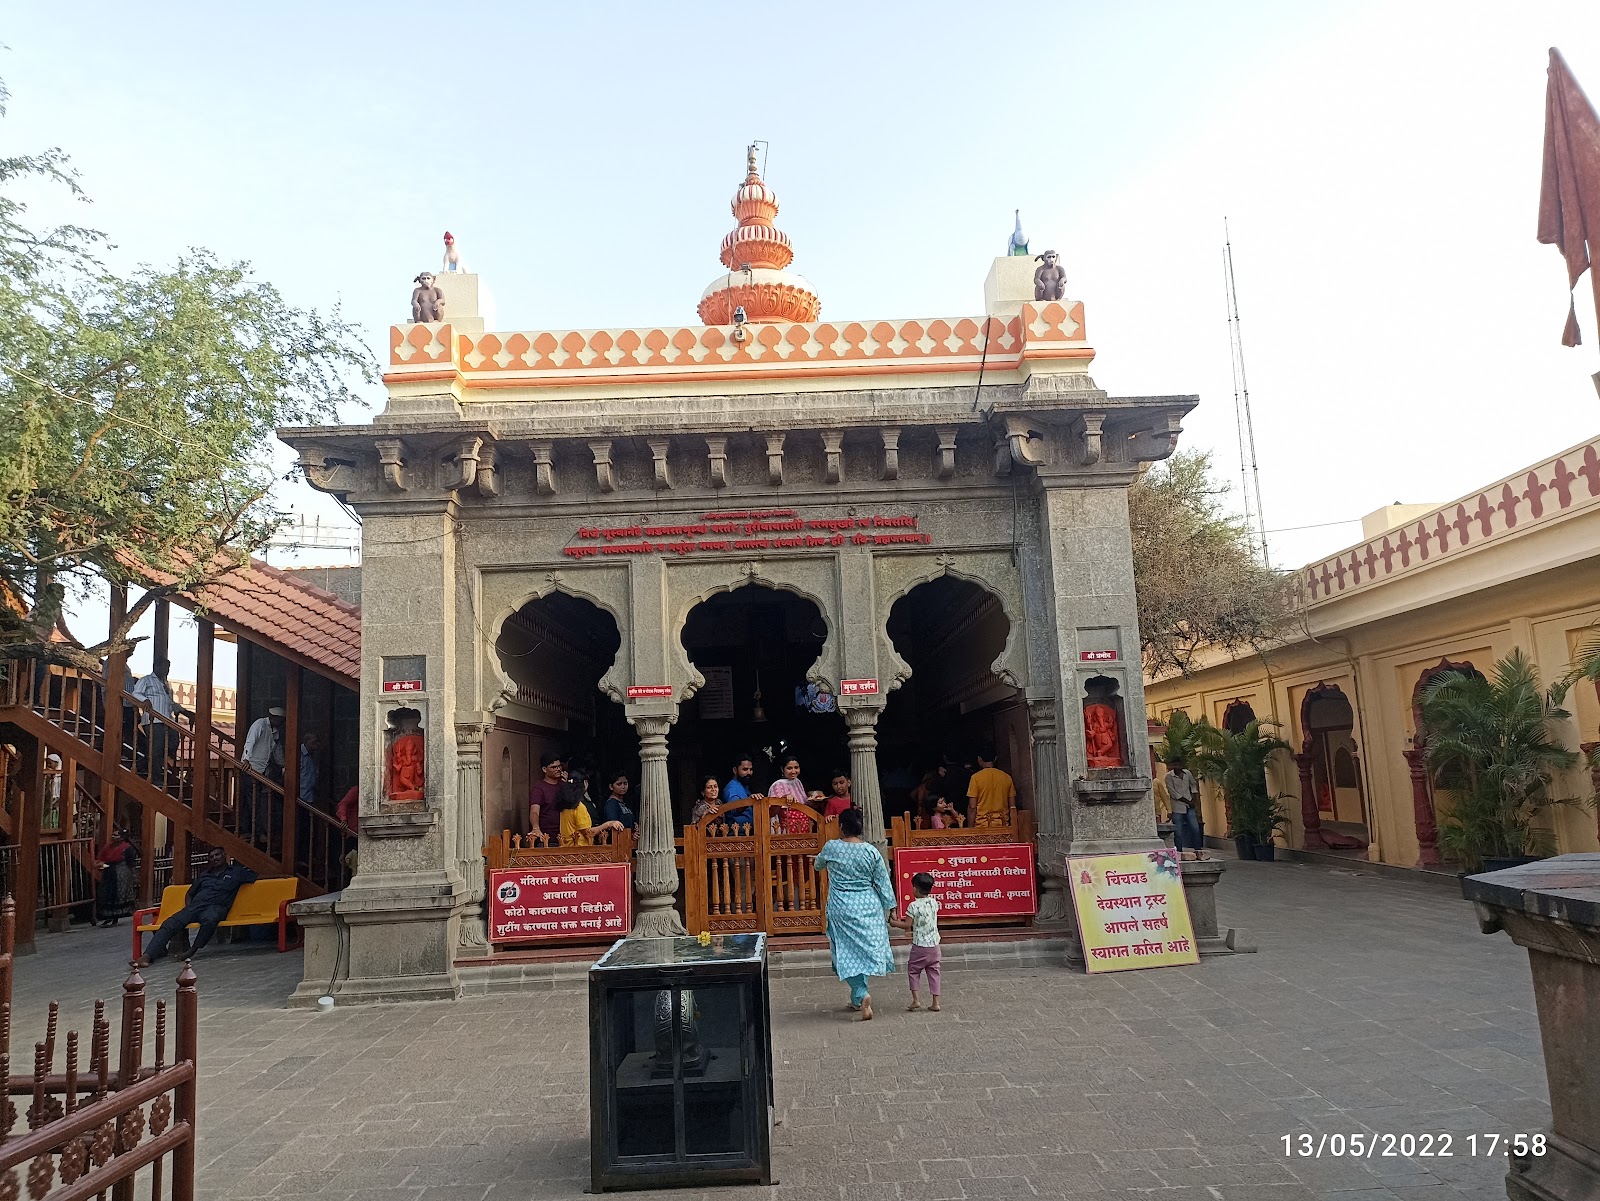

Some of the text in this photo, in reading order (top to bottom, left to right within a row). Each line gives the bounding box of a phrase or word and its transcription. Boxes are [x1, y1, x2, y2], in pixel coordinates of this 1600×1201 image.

[843, 681, 876, 694] मुख दर्शन
[948, 856, 978, 867] सुचना
[958, 867, 1001, 878] दर्शनासाठी
[1004, 866, 1027, 876] विशेष
[1106, 870, 1148, 886] चिंचवड
[520, 873, 599, 886] मंदिरात व मंदिराच्या
[543, 890, 577, 901] आवारात
[946, 890, 962, 901] दिले
[965, 892, 982, 900] जात
[1007, 890, 1030, 901] कृपया
[1097, 894, 1167, 911] देवस्थान ट्रस्ट
[504, 901, 615, 917] फोटो काढण्यास व व्हिडीओ
[497, 916, 622, 936] शुटींग करण्यास सक्त मनाई आहे
[1104, 912, 1169, 934] आपले सहर्ष
[1091, 936, 1191, 960] स्वागत करित आहे
